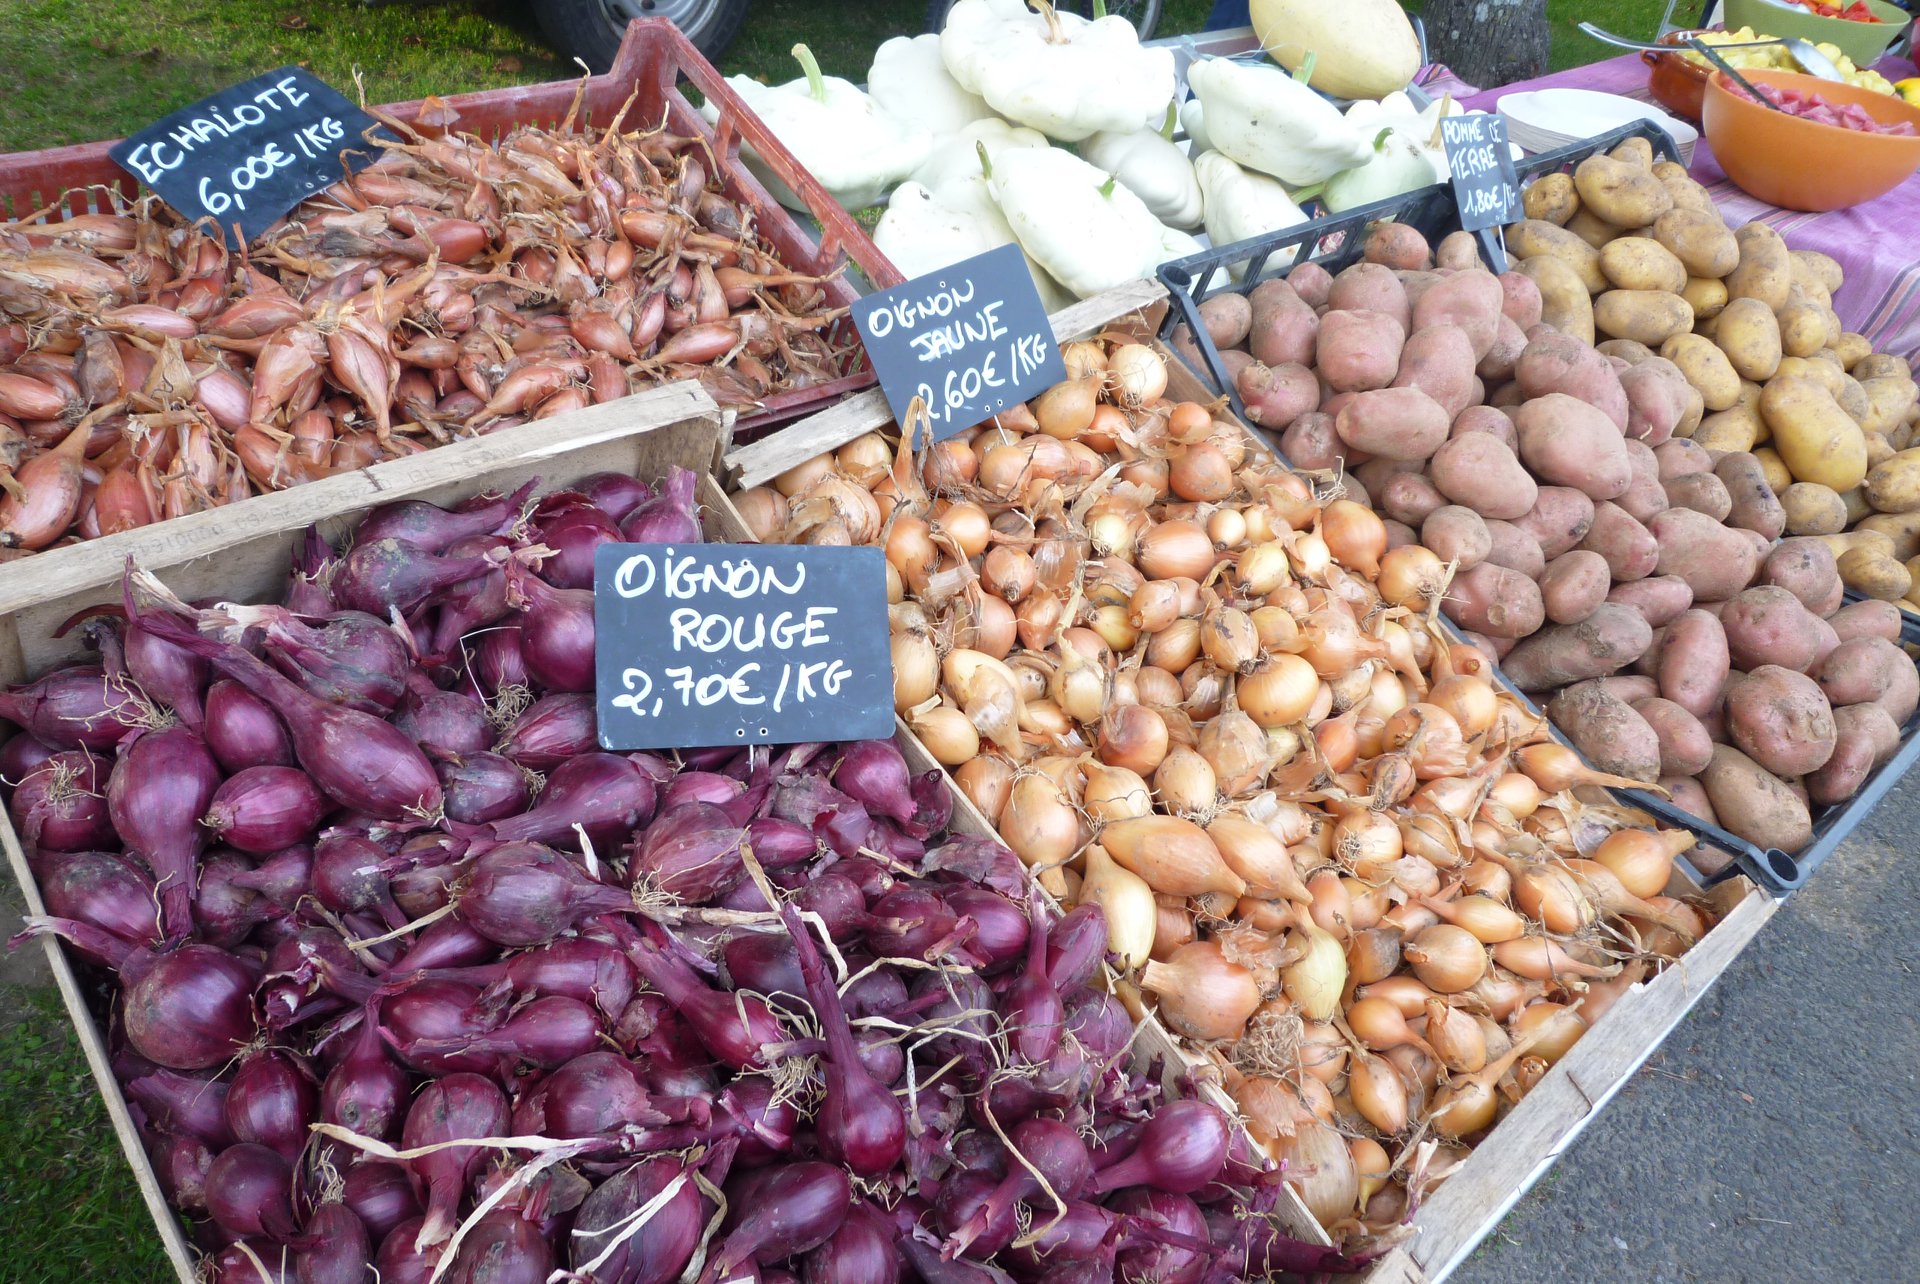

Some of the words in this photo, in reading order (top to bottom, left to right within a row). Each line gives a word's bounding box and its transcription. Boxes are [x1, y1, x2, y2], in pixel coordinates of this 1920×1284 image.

[127, 76, 309, 184] ECHALOTE
[1442, 117, 1485, 145] POMME
[1450, 143, 1498, 180] TERRE
[909, 300, 1008, 362] JAUNE
[669, 606, 839, 653] ROUGE
